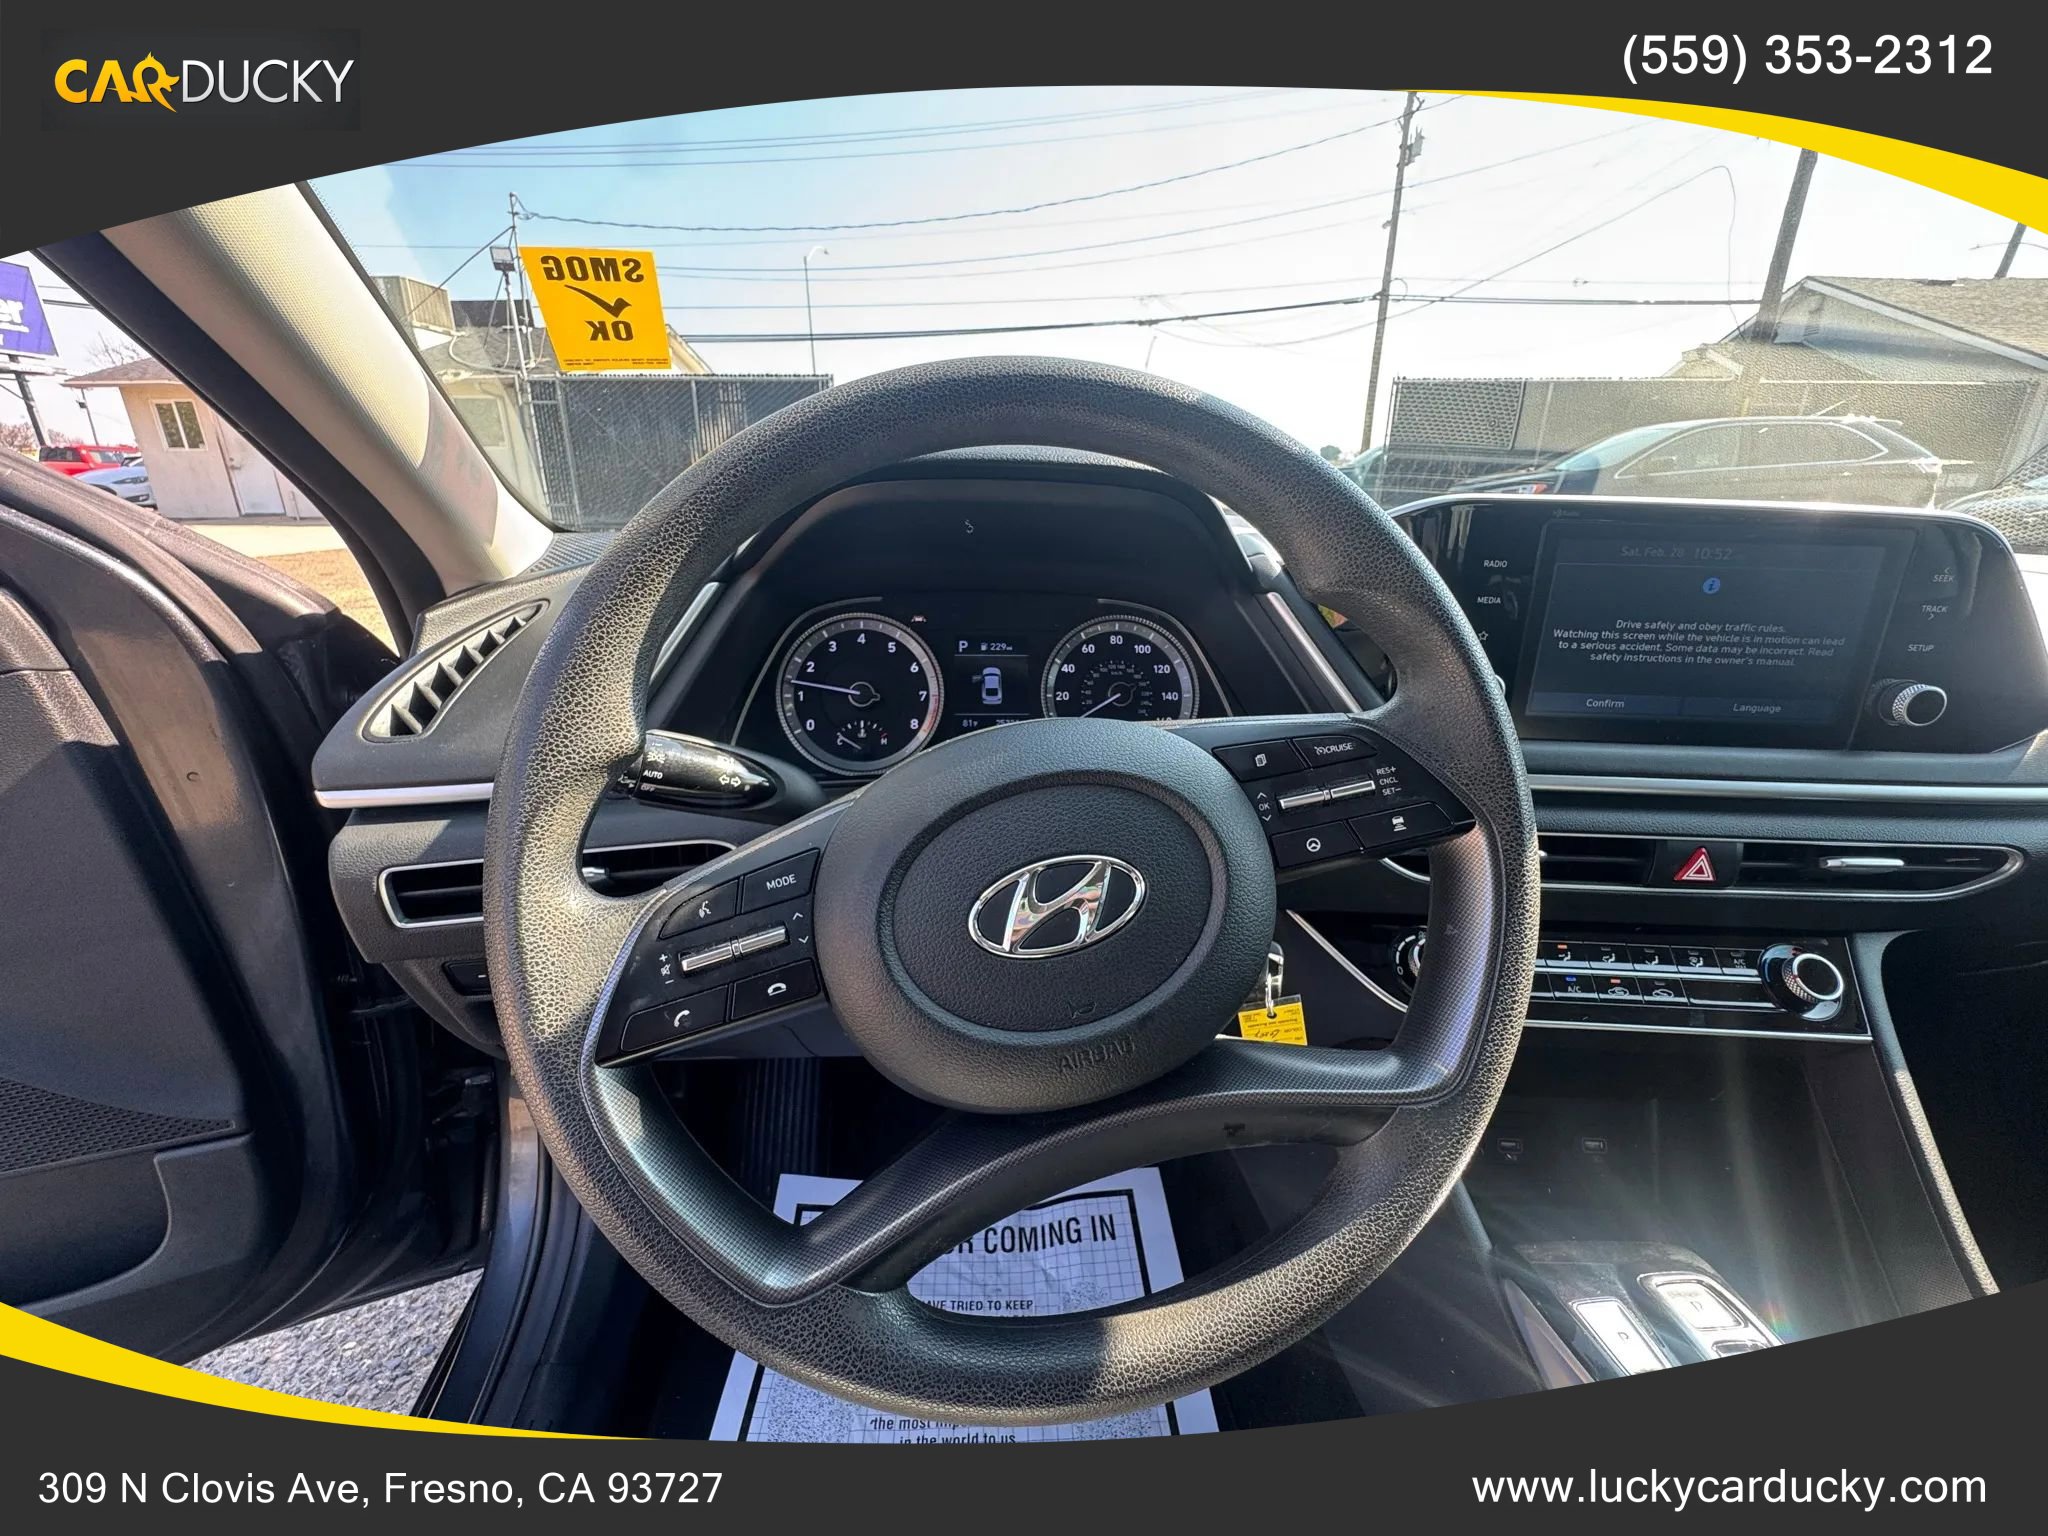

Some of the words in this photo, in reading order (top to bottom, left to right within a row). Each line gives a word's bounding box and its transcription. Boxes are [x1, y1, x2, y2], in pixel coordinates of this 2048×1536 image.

[1693, 547, 1733, 560] 10:52
[1483, 559, 1508, 569] RADIO
[1932, 574, 1954, 583] SEEK
[1476, 596, 1502, 605] MEDIA
[1921, 604, 1948, 614] TRACK
[1616, 619, 1642, 629] Drive
[1644, 620, 1676, 631] safely
[1678, 622, 1697, 630] and
[1698, 622, 1723, 632] obey
[1725, 623, 1757, 632] traffic
[857, 633, 866, 644] 4
[1109, 635, 1123, 645] 80
[1553, 629, 1599, 640] Watching
[1601, 630, 1620, 639] this
[1623, 632, 1656, 640] screen
[1658, 632, 1685, 641] while
[1687, 633, 1705, 642] the
[1706, 634, 1740, 643] vehicle
[1742, 635, 1751, 643] is
[1753, 635, 1763, 644] in
[1765, 636, 1800, 645] motion
[1823, 637, 1846, 646] lead
[828, 641, 837, 652] 3
[887, 642, 896, 653] 5
[958, 640, 968, 653] P
[1081, 644, 1095, 654] 60
[1134, 645, 1151, 654] 100
[1558, 641, 1569, 649] to
[1581, 641, 1617, 650] serious
[1619, 642, 1663, 652] accident.
[1665, 643, 1694, 652] Some
[1695, 645, 1718, 653] data
[1721, 646, 1743, 656] may
[1744, 646, 1756, 654] be
[1808, 647, 1835, 657] Read
[1907, 643, 1935, 652] SETUP
[1590, 652, 1622, 663] safety
[1623, 653, 1683, 663] instructions
[1685, 654, 1694, 663] in
[1696, 656, 1713, 665] the
[1714, 656, 1753, 665] owner's
[806, 661, 815, 673] 2
[910, 662, 919, 673] 6
[1061, 664, 1075, 673] 40
[1153, 664, 1170, 674] 120
[798, 691, 804, 701] 1
[919, 691, 928, 701] 7
[1055, 691, 1069, 701] 20
[1161, 691, 1179, 701] 140
[1586, 698, 1625, 708] Confirm
[1732, 703, 1782, 714] Language
[806, 719, 815, 731] 0
[910, 718, 919, 729] 8
[1324, 742, 1354, 754] CRUISE
[642, 769, 664, 780] AUTO
[1376, 765, 1397, 776] RES+
[1379, 776, 1399, 786] CNCL
[1258, 802, 1270, 811] OK
[766, 874, 797, 891] MODE
[1567, 985, 1582, 994] A/C
[983, 1216, 1082, 1255] COMING
[1090, 1213, 1117, 1243] IN
[951, 1300, 984, 1311] TRIED
[987, 1300, 1001, 1311] TO
[1005, 1300, 1034, 1311] KEEP
[941, 1433, 979, 1444] world
[983, 1433, 996, 1444] to
[1000, 1434, 1016, 1444] us
